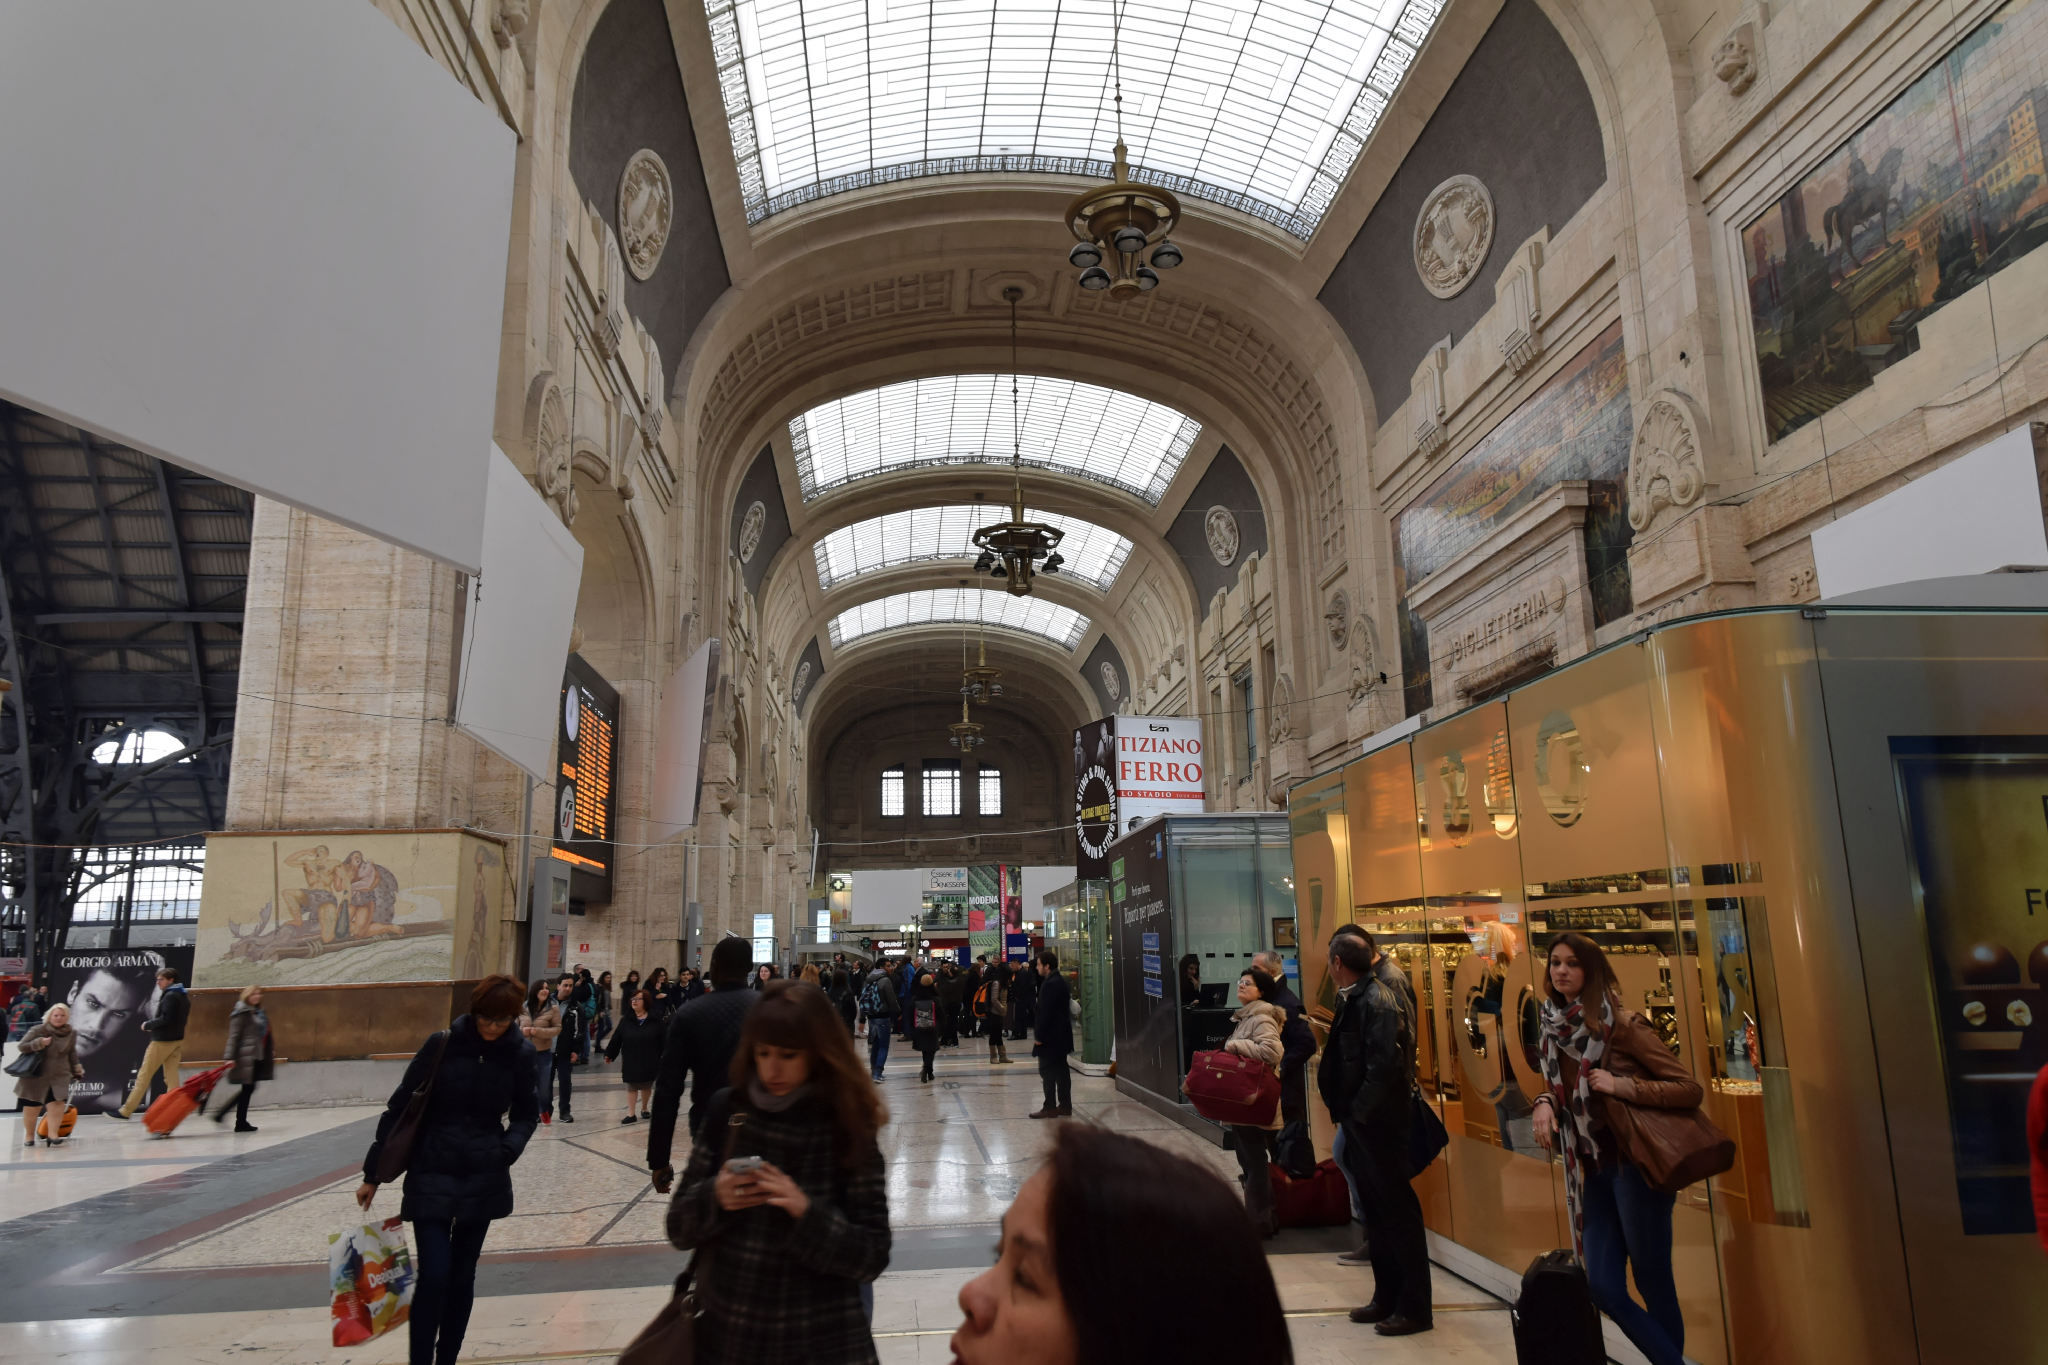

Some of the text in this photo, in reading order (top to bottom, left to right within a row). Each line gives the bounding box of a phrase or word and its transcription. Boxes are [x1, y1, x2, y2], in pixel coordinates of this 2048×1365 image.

[1454, 590, 1548, 662] BIGLIETTERIA
[1118, 736, 1202, 754] TIZIANO
[1118, 761, 1202, 782] FERRO
[1077, 773, 1089, 802] STING
[1094, 765, 1106, 782] PAUL
[1105, 776, 1116, 810] SIMON
[968, 896, 999, 904] MODENA
[61, 955, 161, 968] GIORGIO ARMANI
[368, 1262, 406, 1288] Desigual
